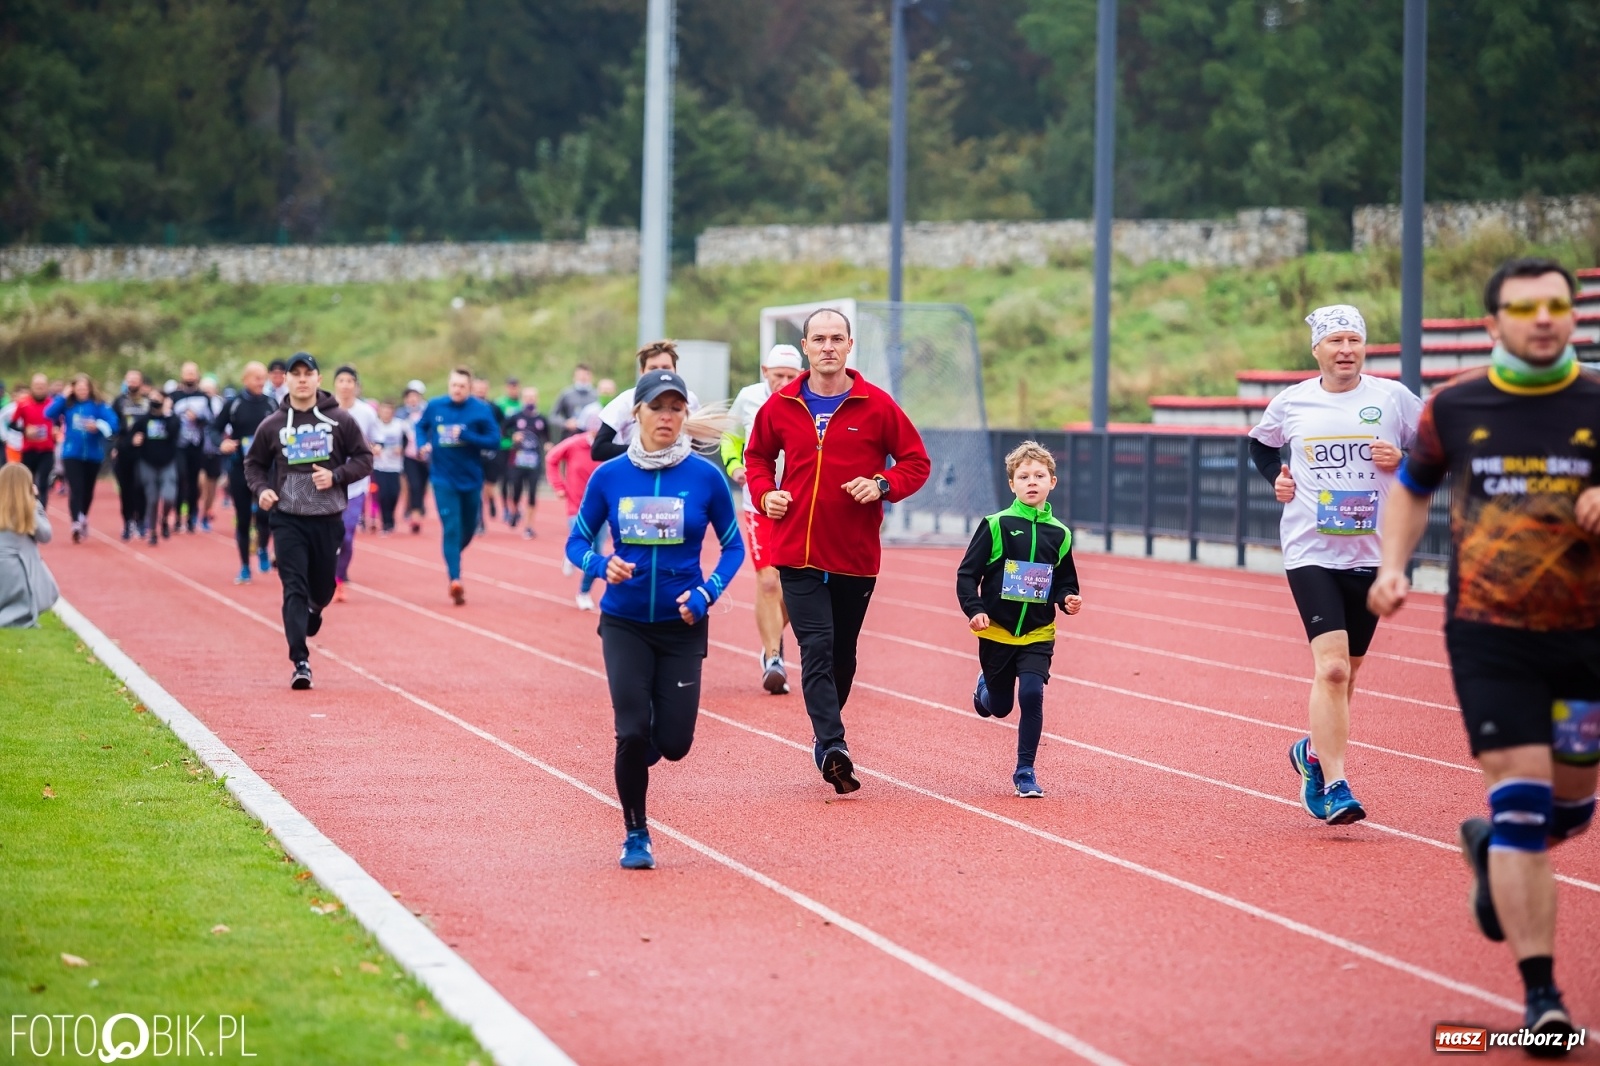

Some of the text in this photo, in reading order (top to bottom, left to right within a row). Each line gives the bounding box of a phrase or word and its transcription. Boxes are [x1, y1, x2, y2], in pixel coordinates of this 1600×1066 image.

[1314, 436, 1379, 469] agro
[1354, 520, 1373, 529] 233
[657, 528, 677, 538] 115
[1034, 590, 1047, 598] 051
